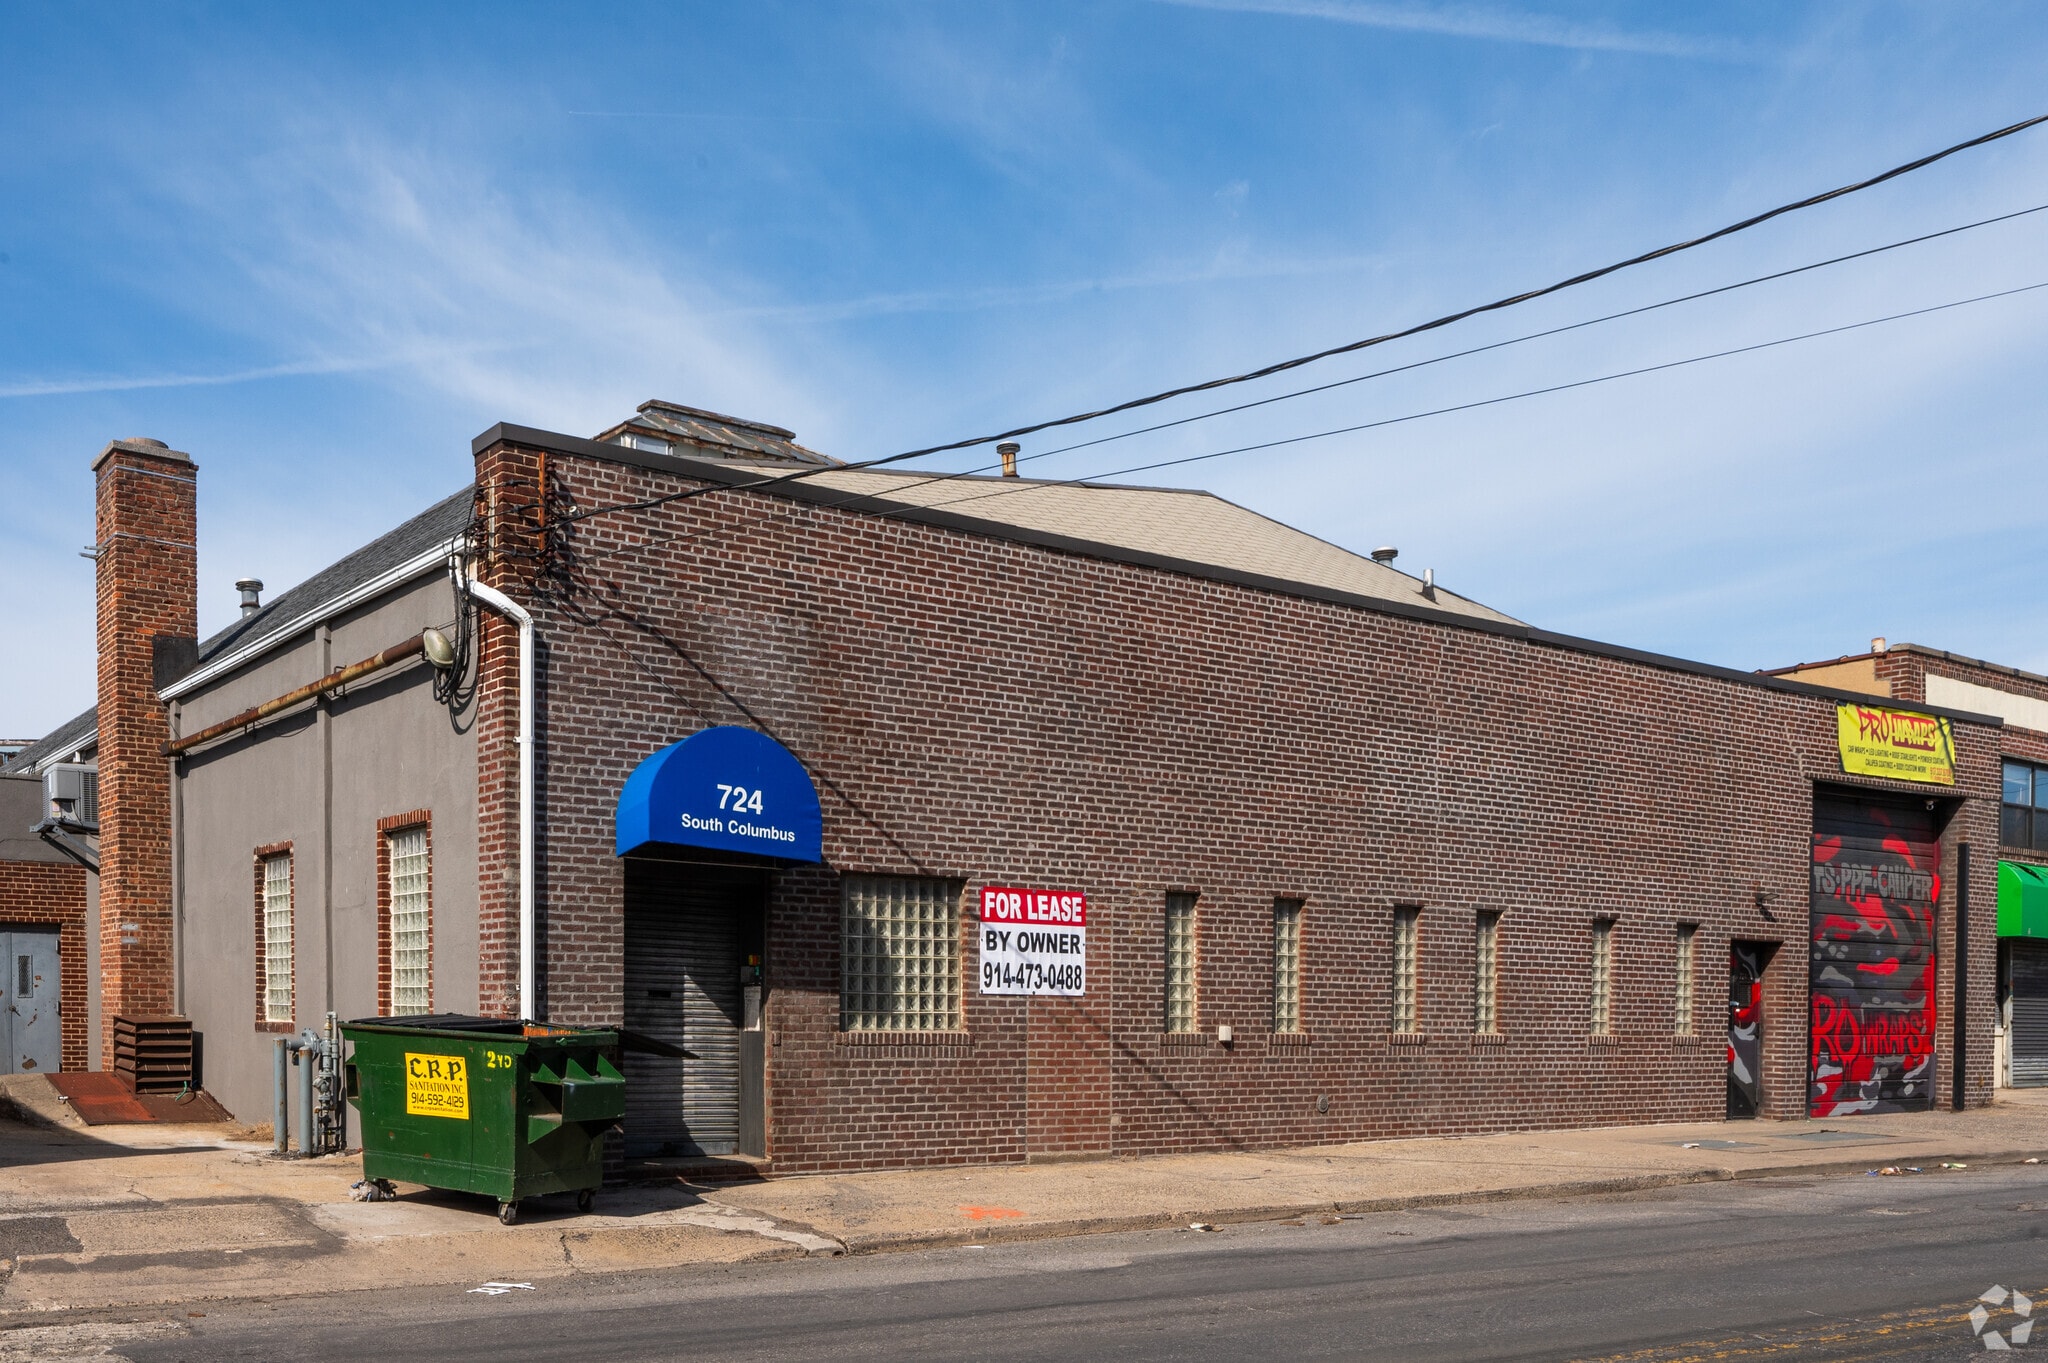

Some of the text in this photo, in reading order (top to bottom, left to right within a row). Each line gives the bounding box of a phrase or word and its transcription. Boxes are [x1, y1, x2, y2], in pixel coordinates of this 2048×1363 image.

[1855, 705, 1935, 747] PRO WRAPS
[716, 783, 764, 815] 724
[681, 813, 796, 842] South Columbus
[1878, 864, 1934, 902] CALIPER
[985, 891, 1083, 922] FOR LEASE
[985, 930, 1081, 954] BY OWNER
[984, 961, 1082, 990] 914-473-0488
[1864, 1010, 1924, 1056] WRAPS
[410, 1057, 463, 1081] C.R.P.
[410, 1081, 450, 1092] SANITATION
[411, 1092, 464, 1108] 914-592-4129
